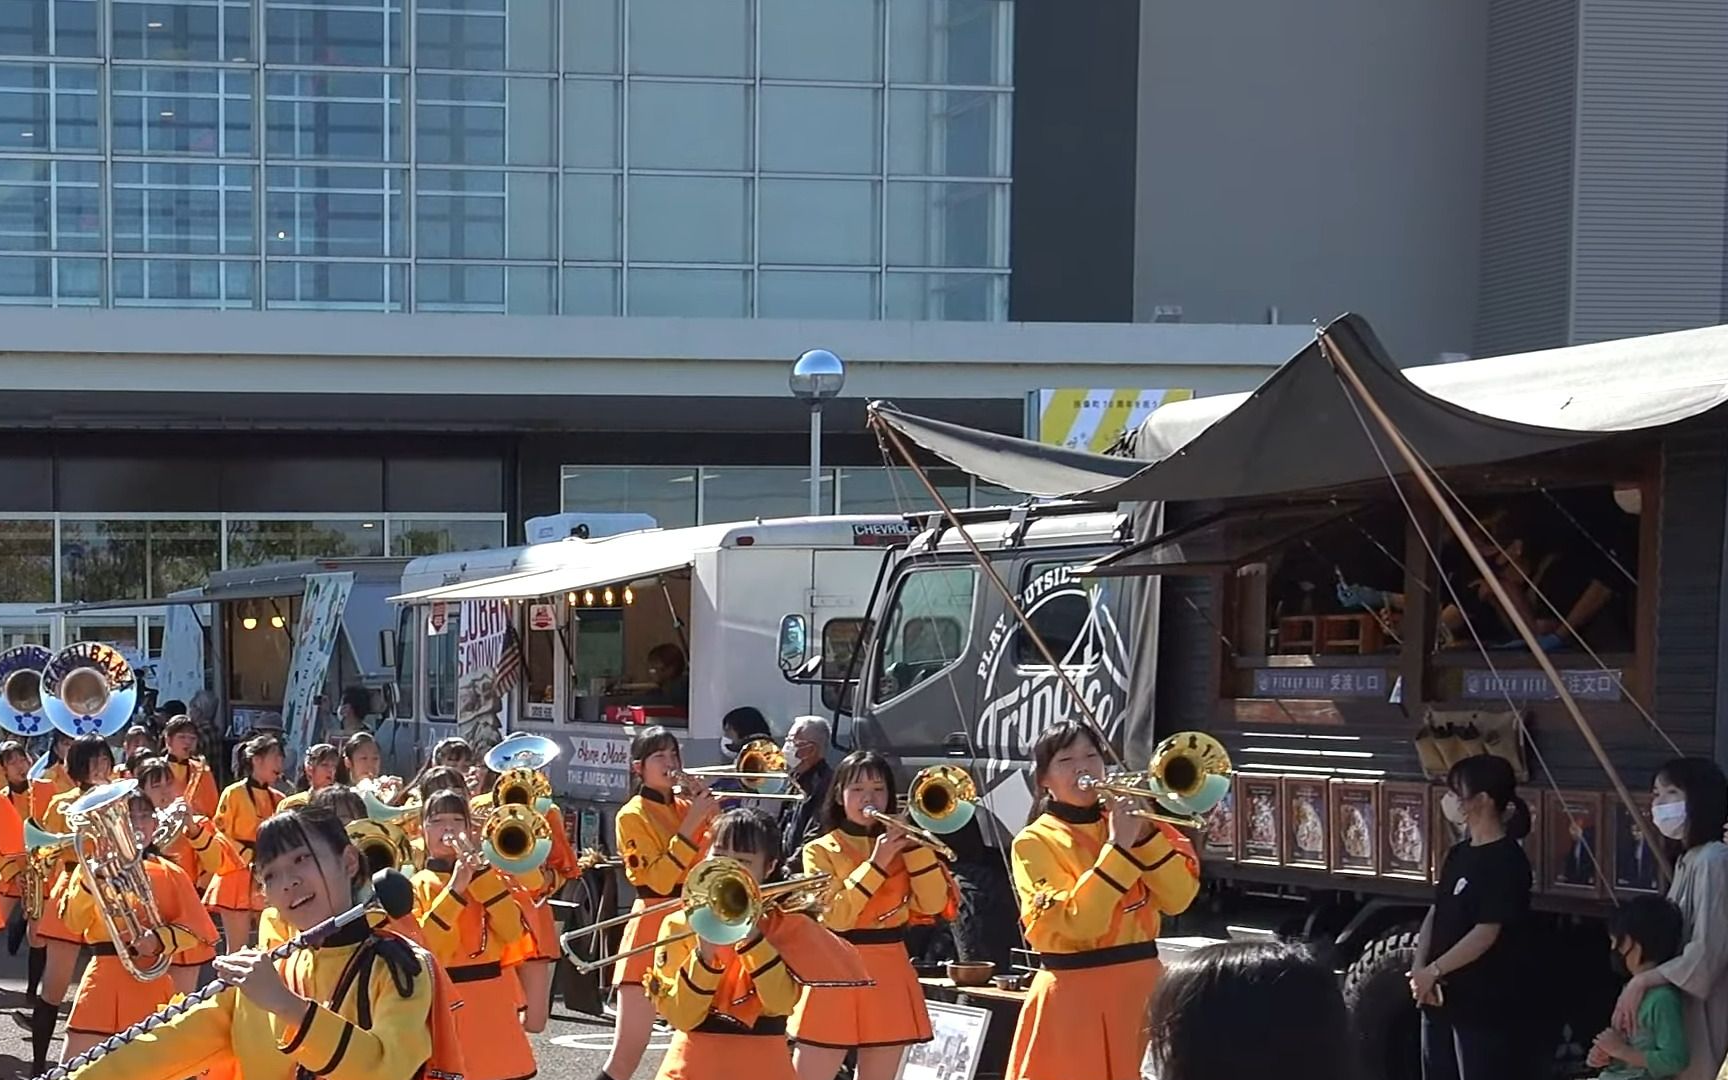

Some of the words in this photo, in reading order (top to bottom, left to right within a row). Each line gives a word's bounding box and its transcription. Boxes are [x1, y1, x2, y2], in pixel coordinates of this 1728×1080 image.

[854, 523, 918, 536] CHEVROLE
[977, 613, 1006, 680] PLAY
[1013, 566, 1082, 611] UTSID
[1330, 673, 1379, 691] 受渡し口
[1559, 676, 1612, 694] 注文口
[568, 770, 582, 784] THE
[583, 771, 626, 789] AMERICAN
